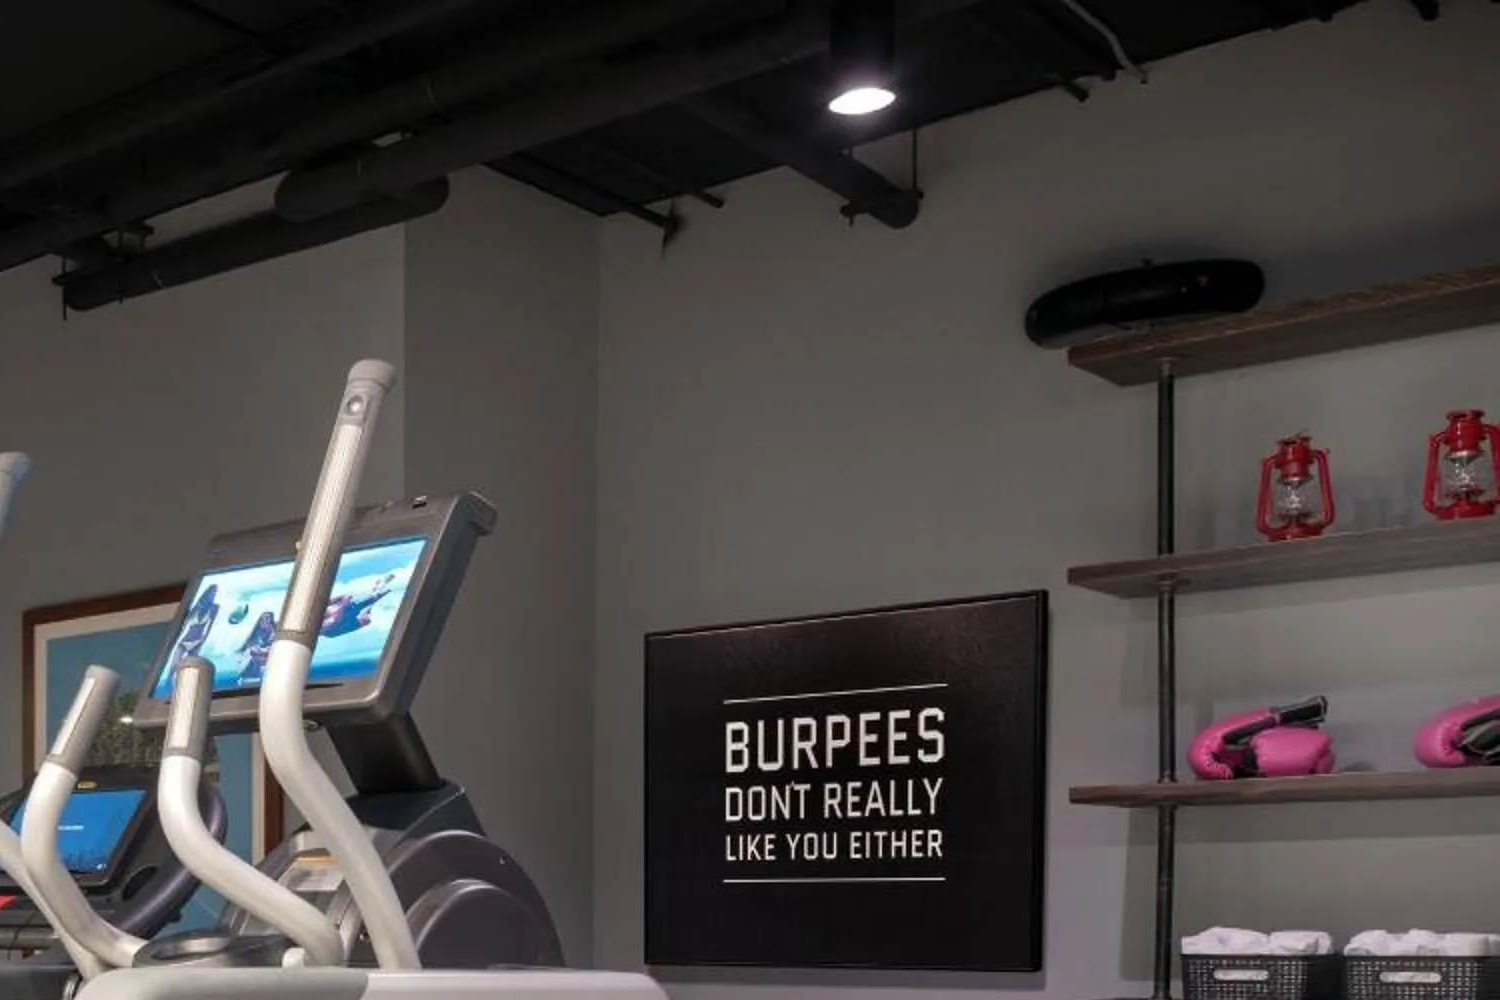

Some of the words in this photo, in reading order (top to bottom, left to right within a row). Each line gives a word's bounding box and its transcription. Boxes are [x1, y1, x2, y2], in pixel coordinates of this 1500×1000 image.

[725, 707, 945, 773] BURPEES
[823, 777, 944, 819] REALLY
[725, 834, 777, 862] LIKE
[785, 831, 838, 861] YOU
[849, 829, 944, 860] EITHER
